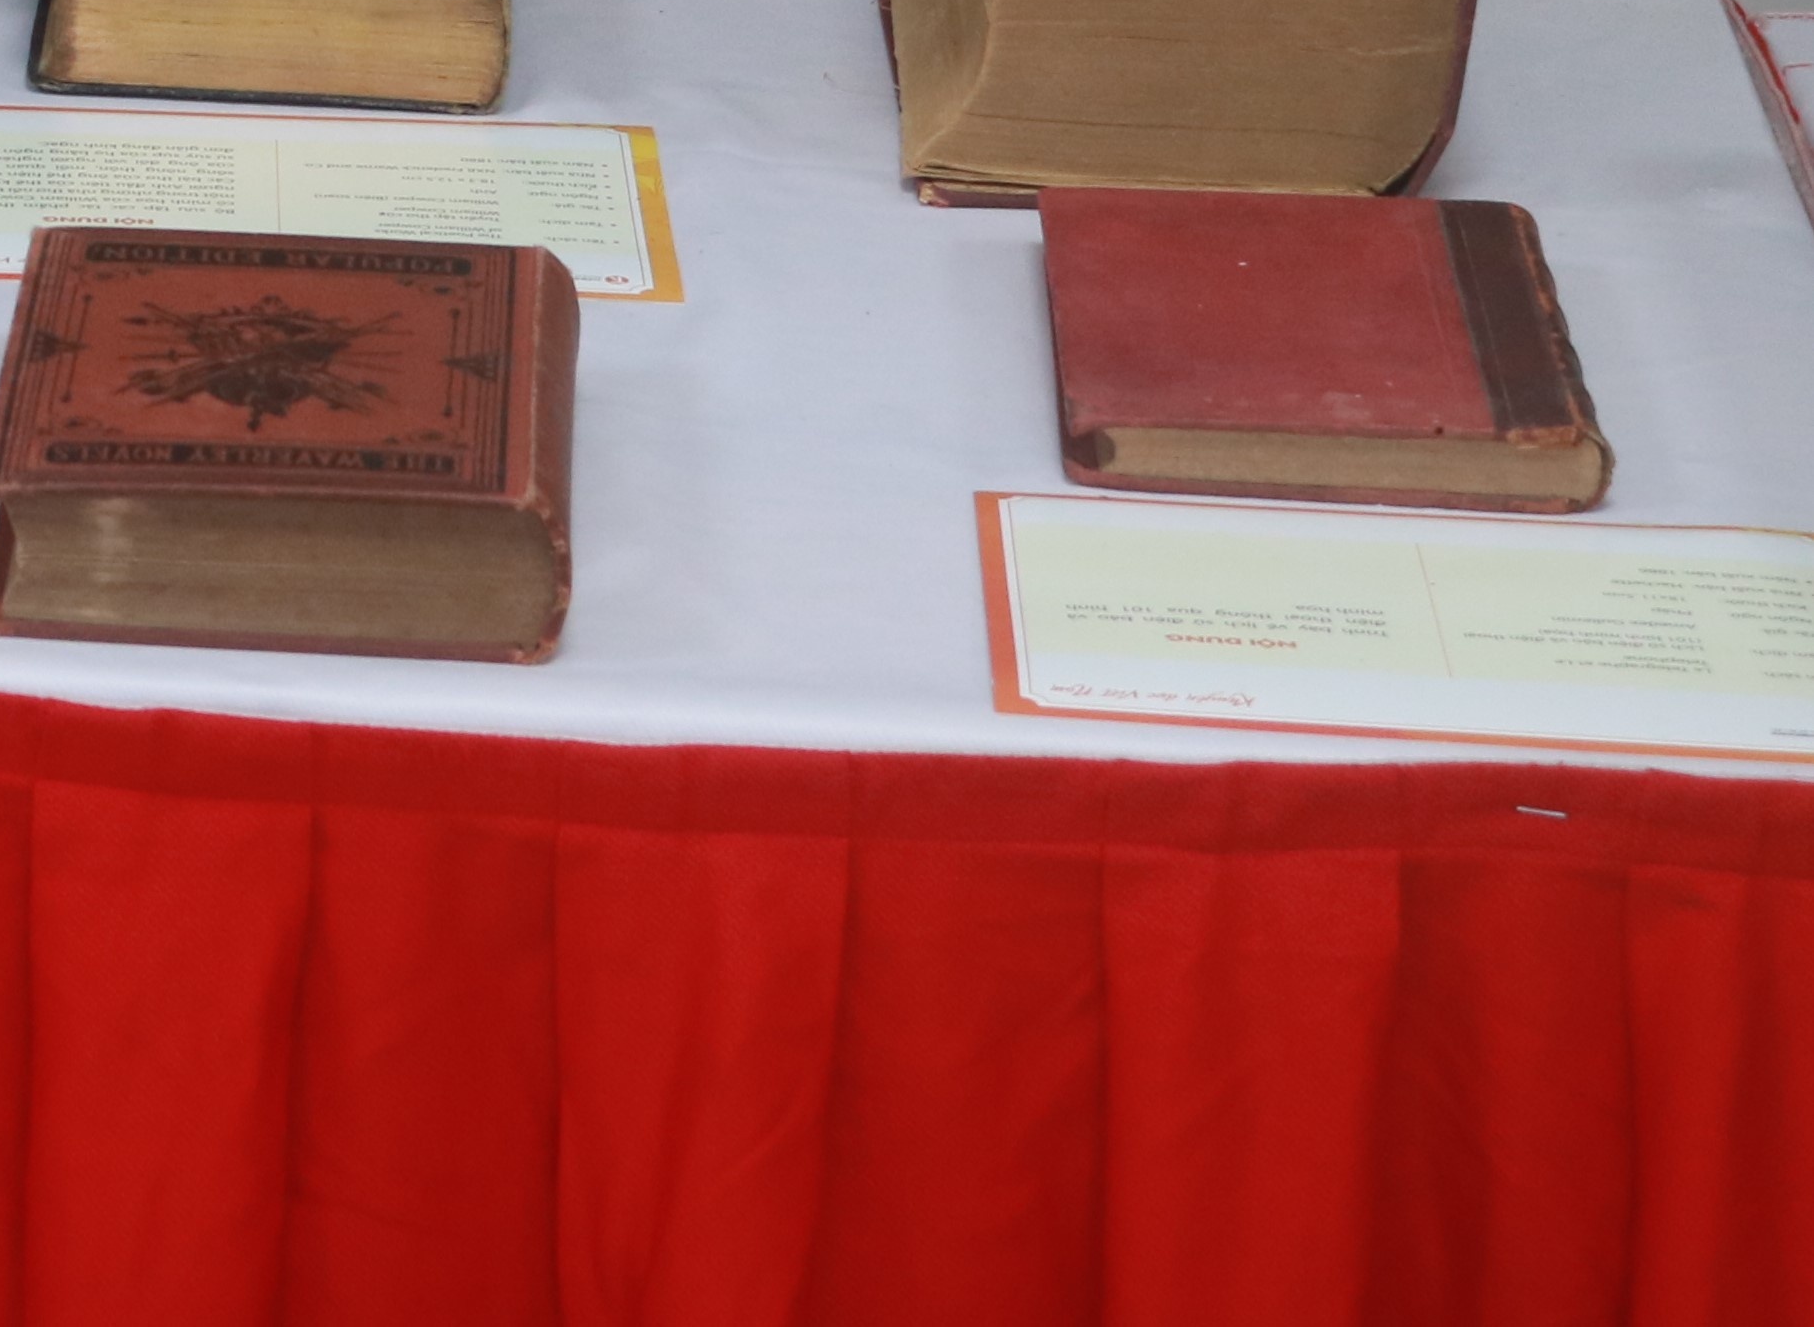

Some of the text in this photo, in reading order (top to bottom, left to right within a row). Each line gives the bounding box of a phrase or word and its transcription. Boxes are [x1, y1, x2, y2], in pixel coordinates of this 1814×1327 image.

[41, 214, 154, 225] NỘI DUNG
[286, 251, 455, 274] POPULAR
[188, 445, 364, 469] WAVERLEY
[1164, 632, 1298, 649] NỘI DUNG
